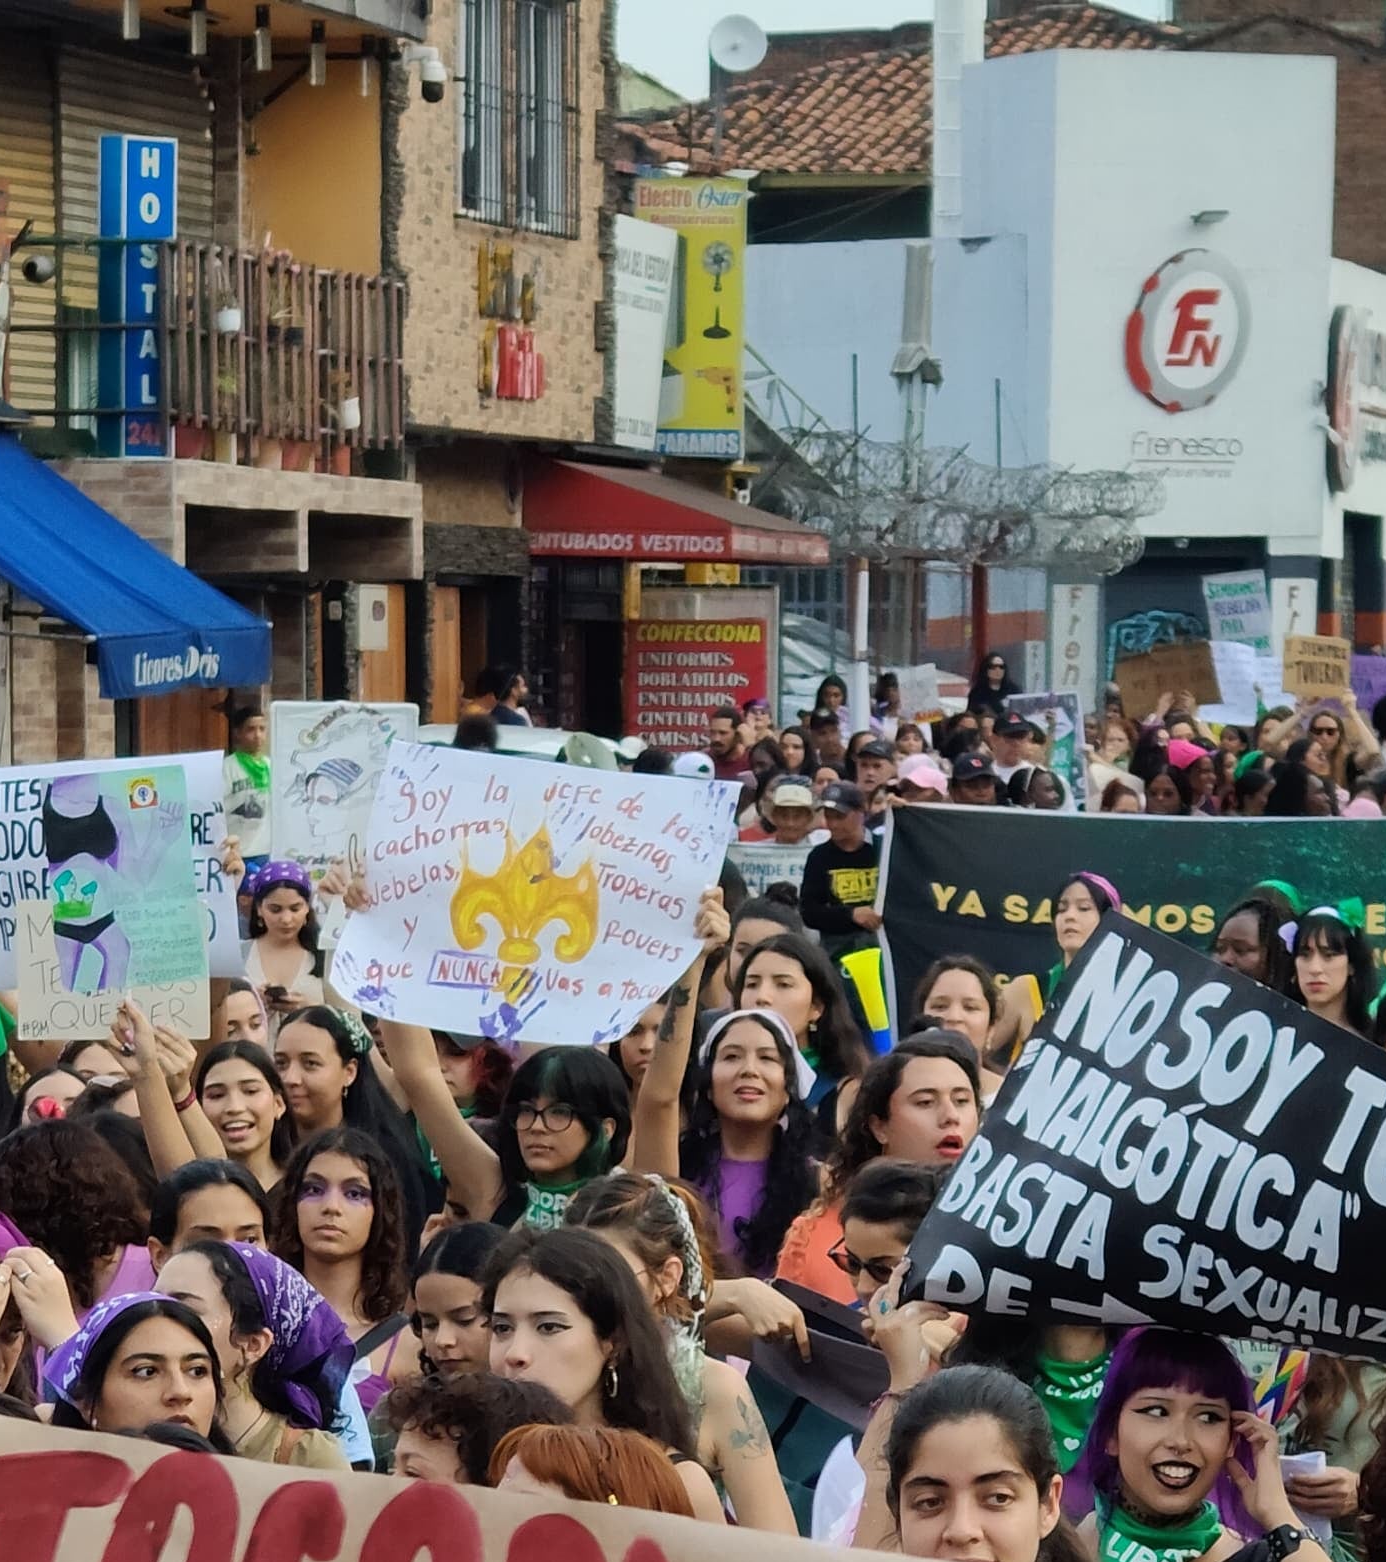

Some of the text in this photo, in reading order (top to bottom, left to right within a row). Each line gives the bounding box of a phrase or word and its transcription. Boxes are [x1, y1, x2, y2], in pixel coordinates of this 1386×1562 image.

[641, 534, 725, 553] VESTIDOS
[637, 624, 762, 643] CONFECCIONA
[134, 651, 184, 687] Licores
[638, 652, 734, 667] UNIFORMES
[638, 672, 750, 687] DOBLADILLOS
[638, 692, 736, 707] ENTUBADOS
[638, 712, 710, 727] CINTURA
[638, 731, 712, 747] CAMISAS
[393, 775, 454, 824] Soy
[483, 774, 510, 804] la
[615, 789, 646, 821] de
[931, 881, 987, 919] YA
[366, 957, 414, 989] que
[436, 957, 502, 985] NUNCA
[1053, 930, 1179, 1070] NO
[1143, 980, 1326, 1136] SOY
[937, 1133, 1113, 1281] BASTA
[922, 1243, 1035, 1316] DE
